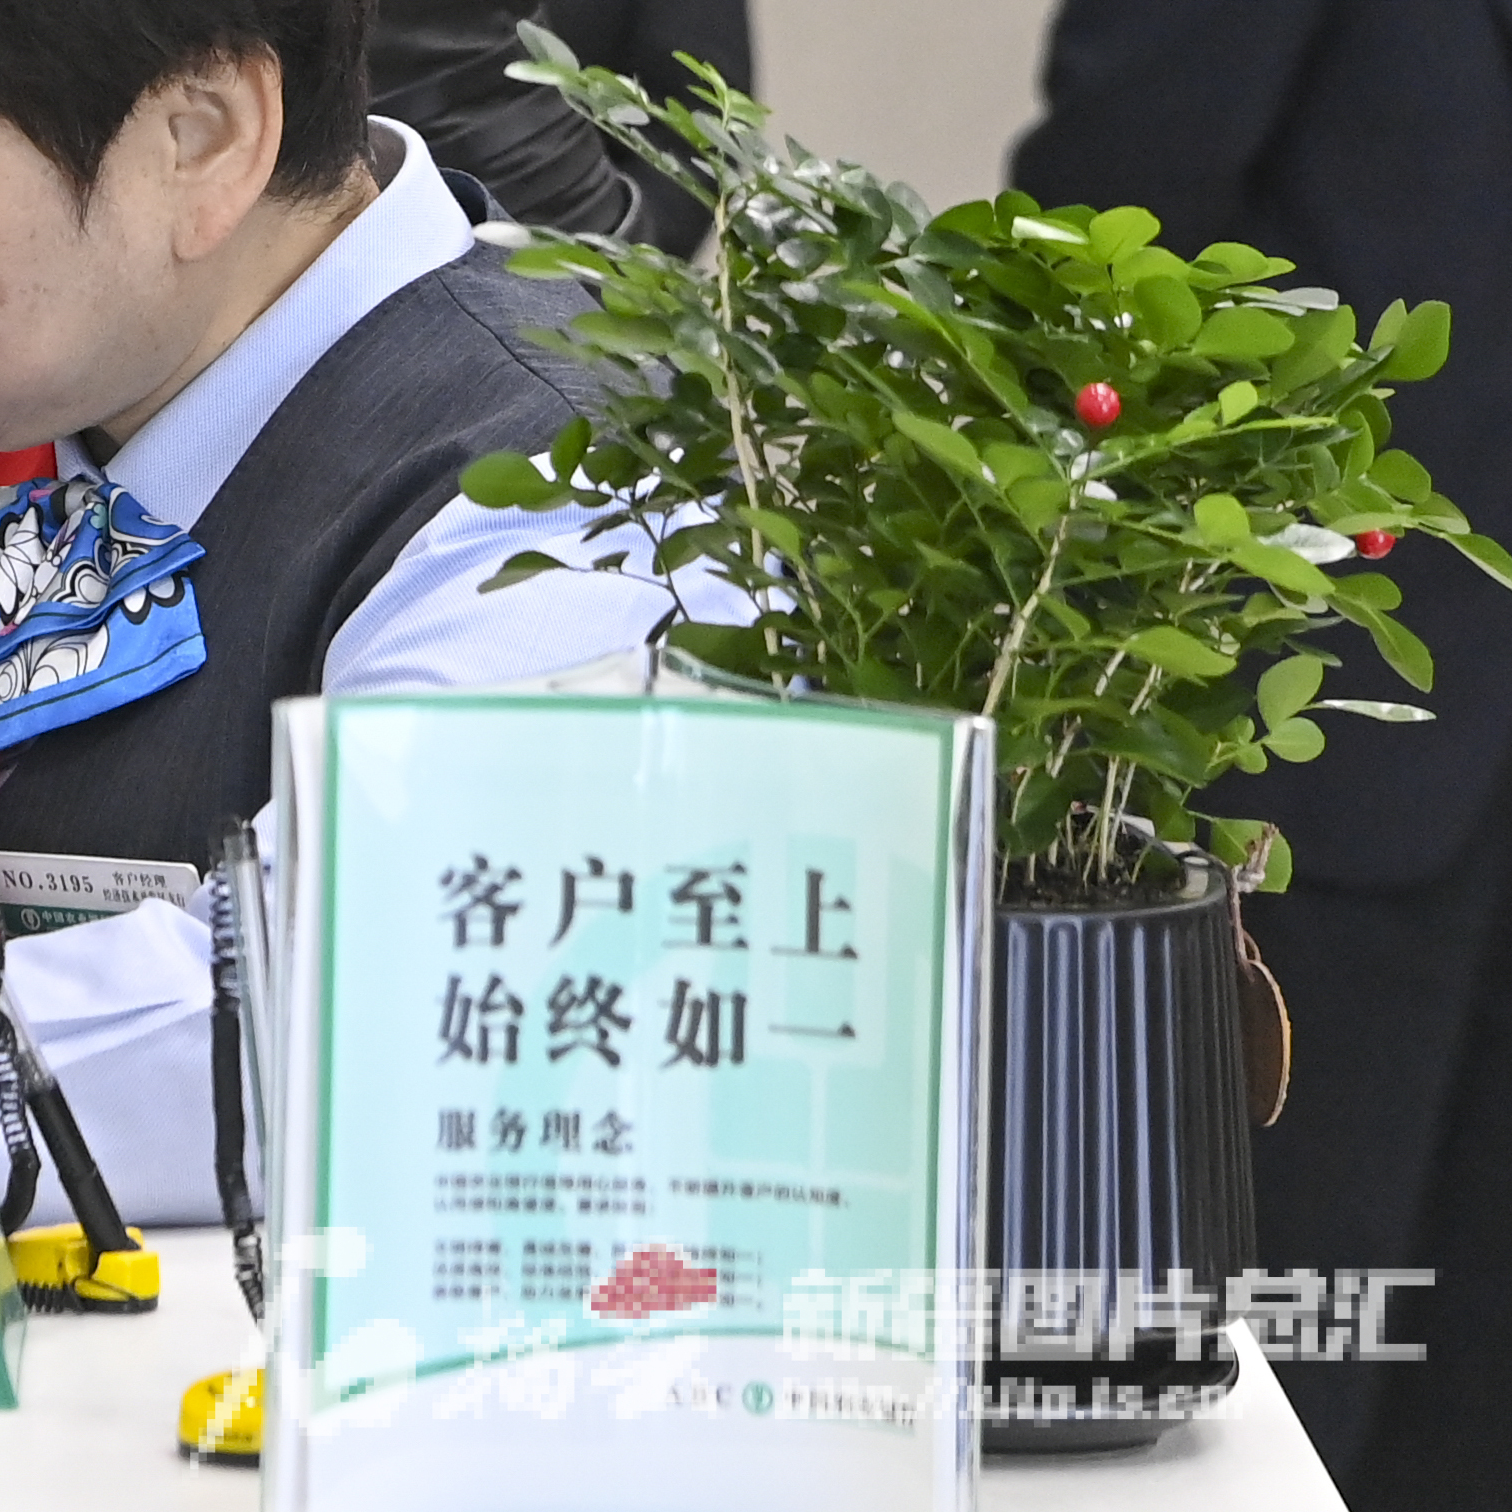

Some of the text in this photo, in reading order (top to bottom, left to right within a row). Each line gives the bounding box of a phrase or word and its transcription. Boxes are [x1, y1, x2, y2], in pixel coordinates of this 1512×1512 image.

[2, 870, 94, 894] NO.3195
[112, 871, 167, 888] 客户经理
[437, 854, 859, 959] 客户至上
[436, 973, 856, 1069] 始终如一
[437, 1106, 634, 1155] 服务理念
